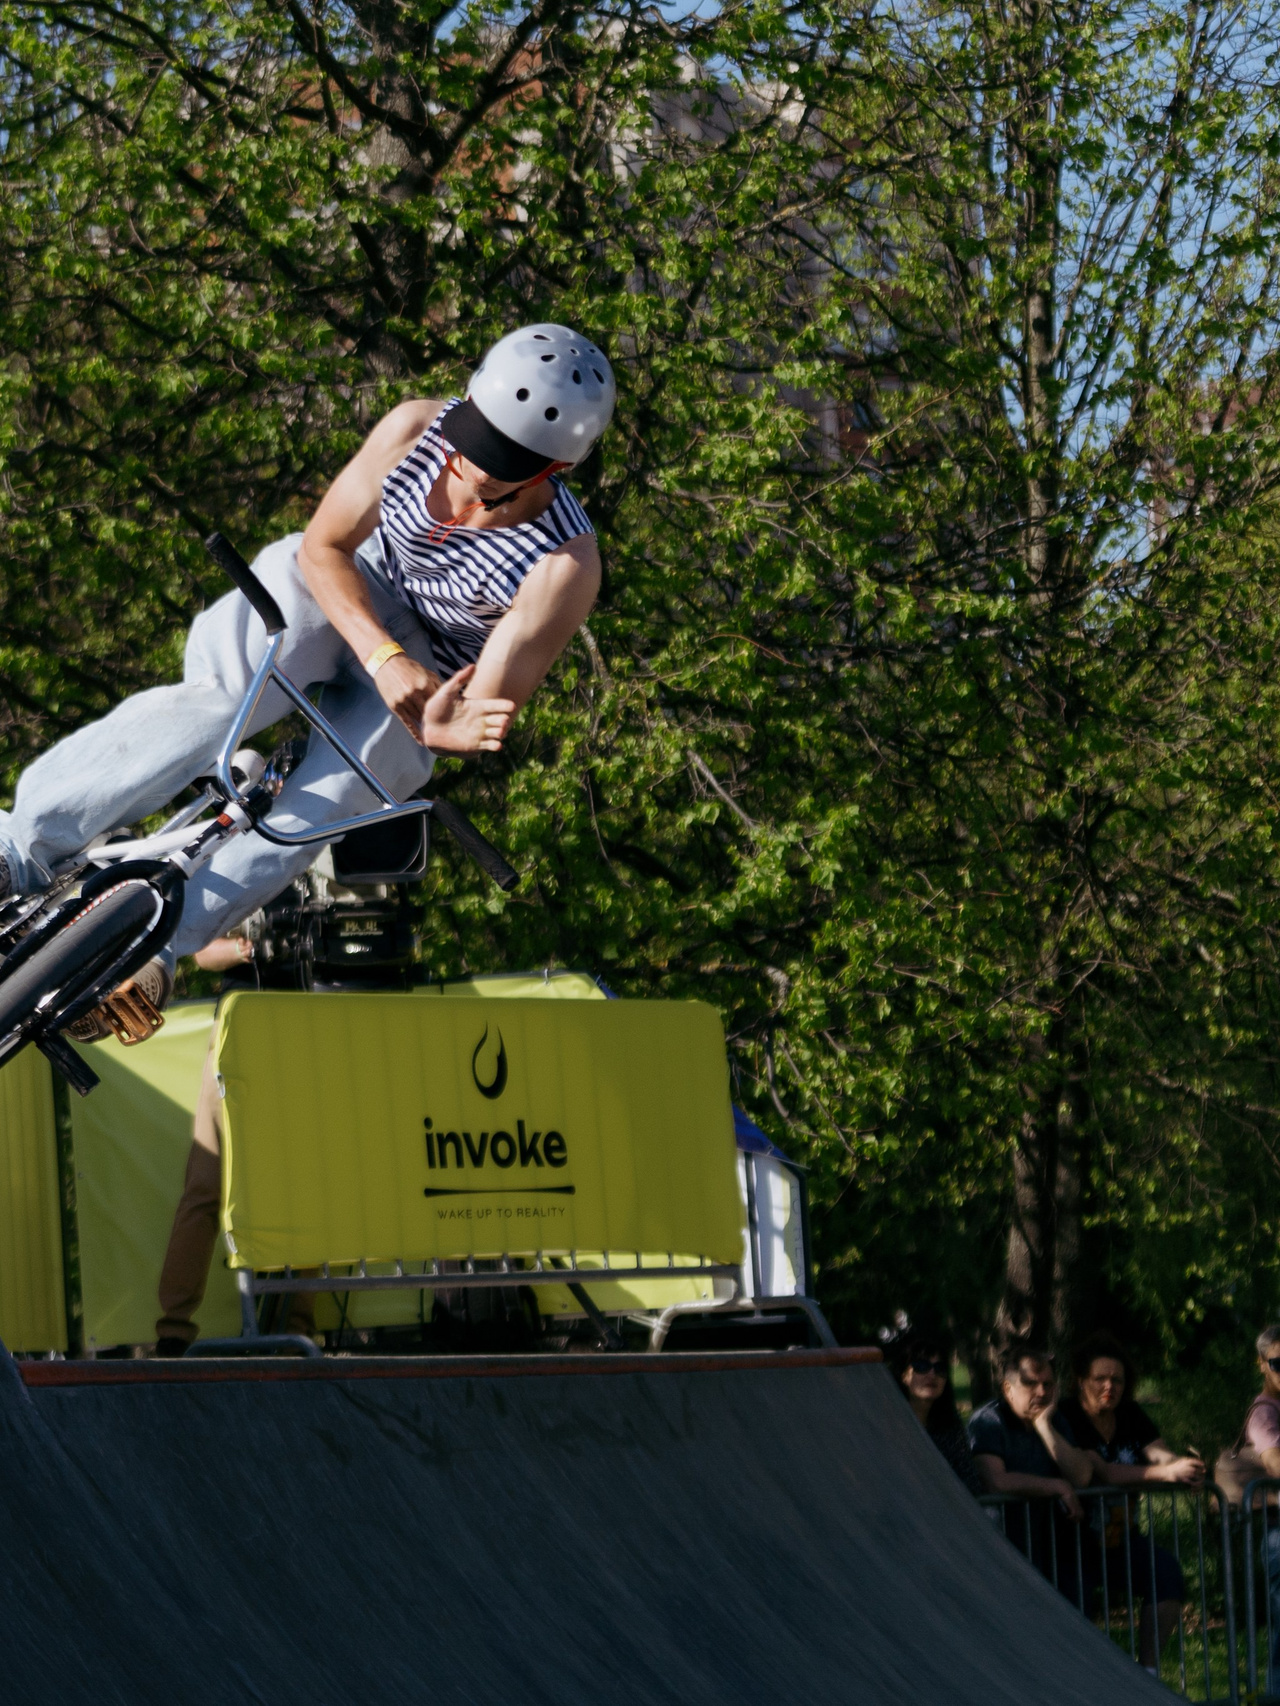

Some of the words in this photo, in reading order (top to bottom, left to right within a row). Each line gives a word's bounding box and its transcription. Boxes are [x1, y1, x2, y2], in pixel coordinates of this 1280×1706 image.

[423, 1117, 568, 1169] invoke
[437, 1209, 473, 1220] WAKE
[476, 1208, 493, 1219] UP
[495, 1208, 513, 1219] TO
[516, 1207, 566, 1218] REALITY
